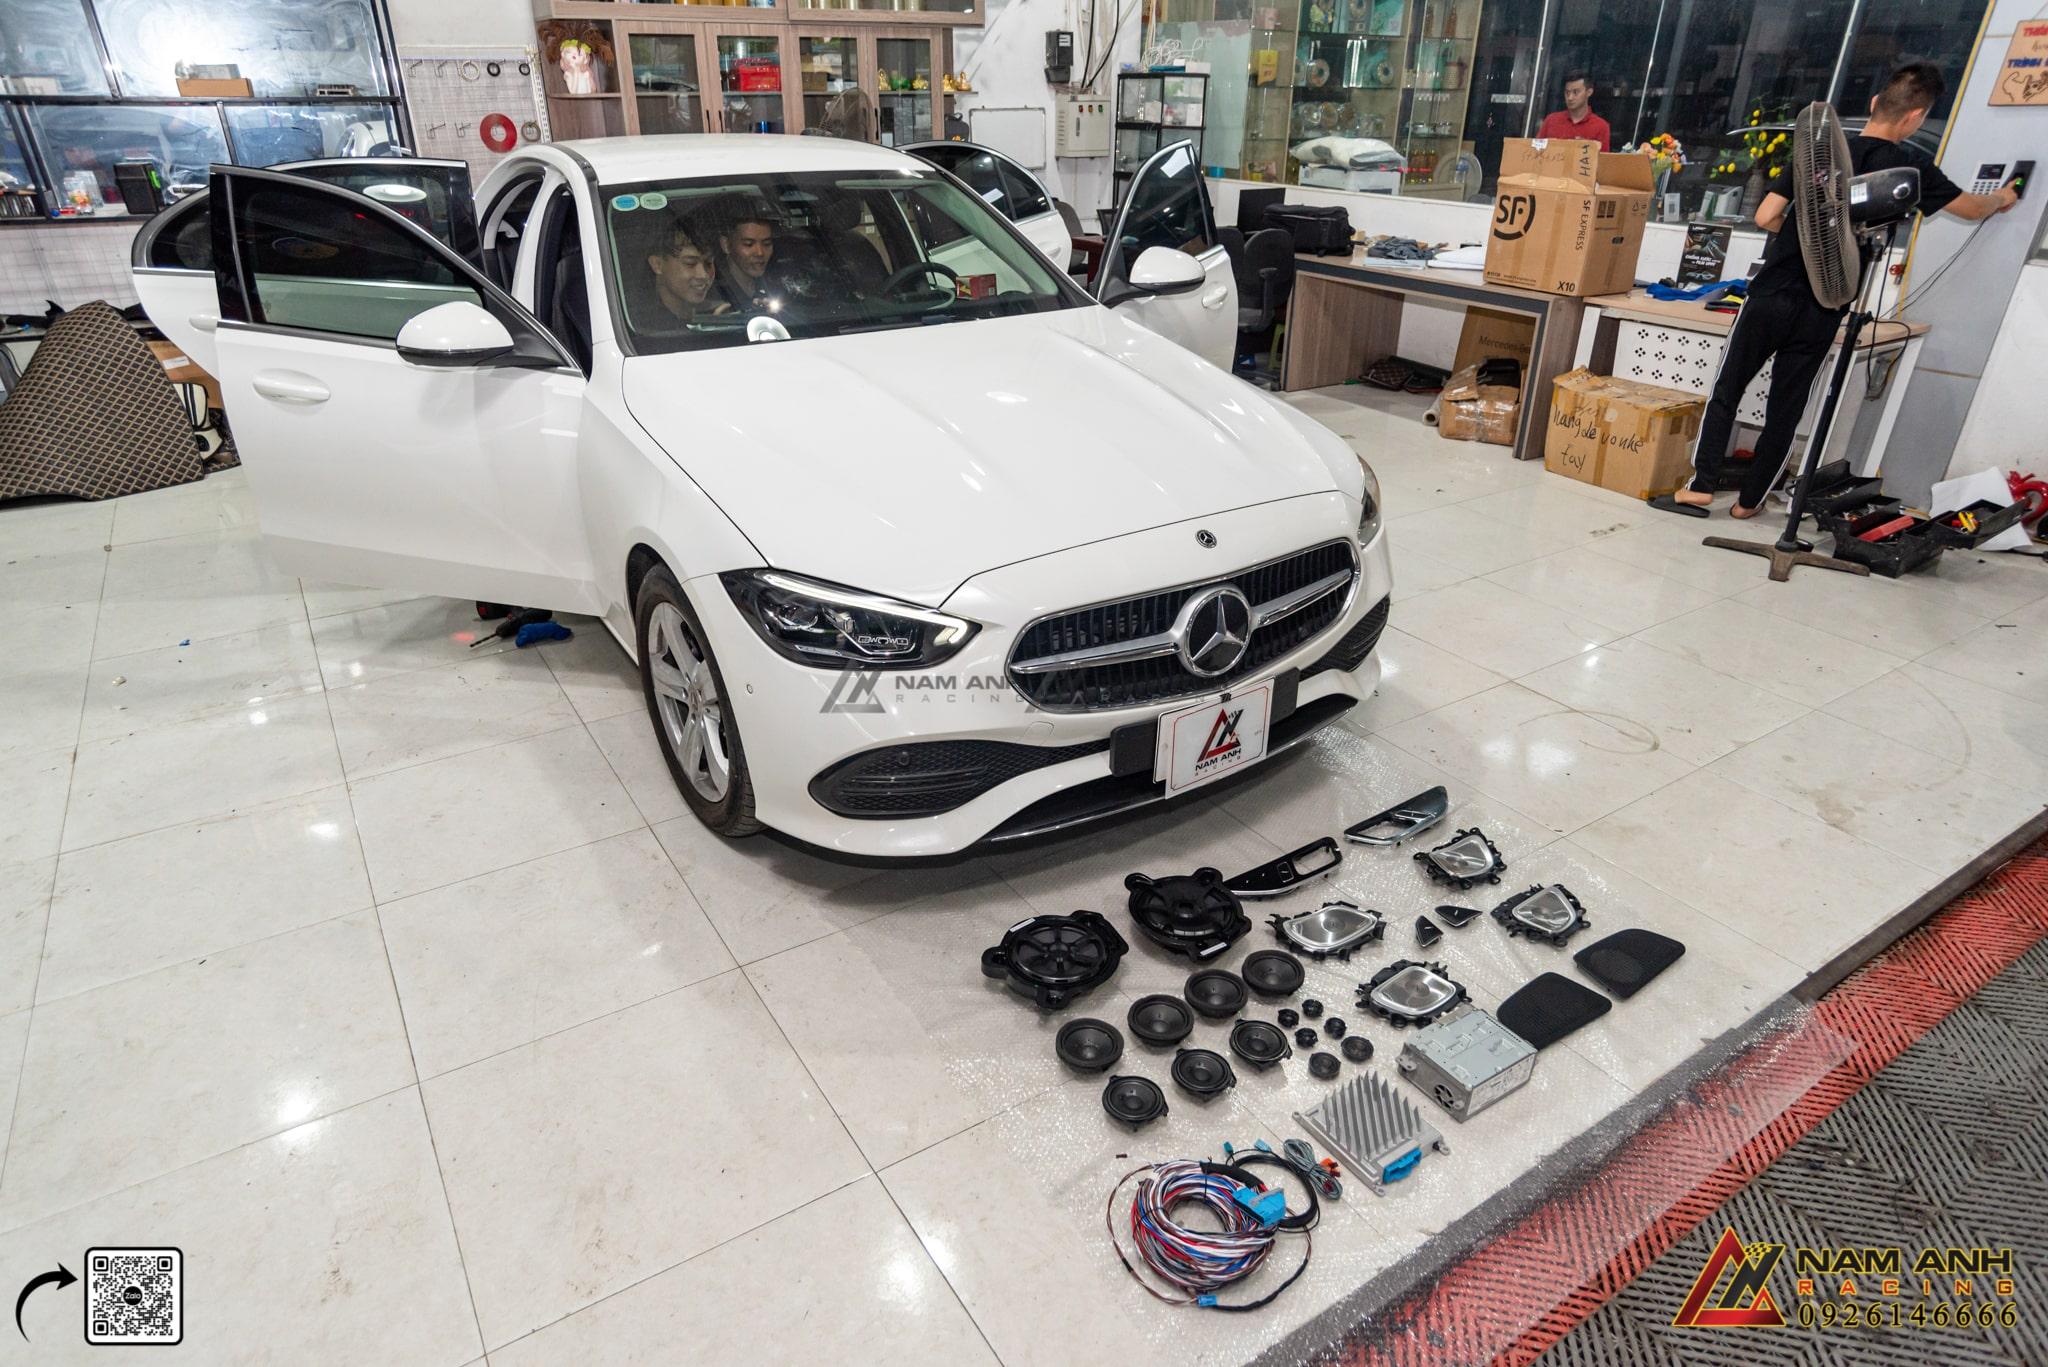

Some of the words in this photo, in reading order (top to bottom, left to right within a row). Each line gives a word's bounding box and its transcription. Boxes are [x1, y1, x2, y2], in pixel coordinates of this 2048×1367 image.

[1582, 199, 1592, 211] SF
[1575, 214, 1590, 251] EXPRESS
[1557, 280, 1576, 292] X10
[1195, 758, 1218, 772] NAM
[1220, 749, 1242, 762] ANH
